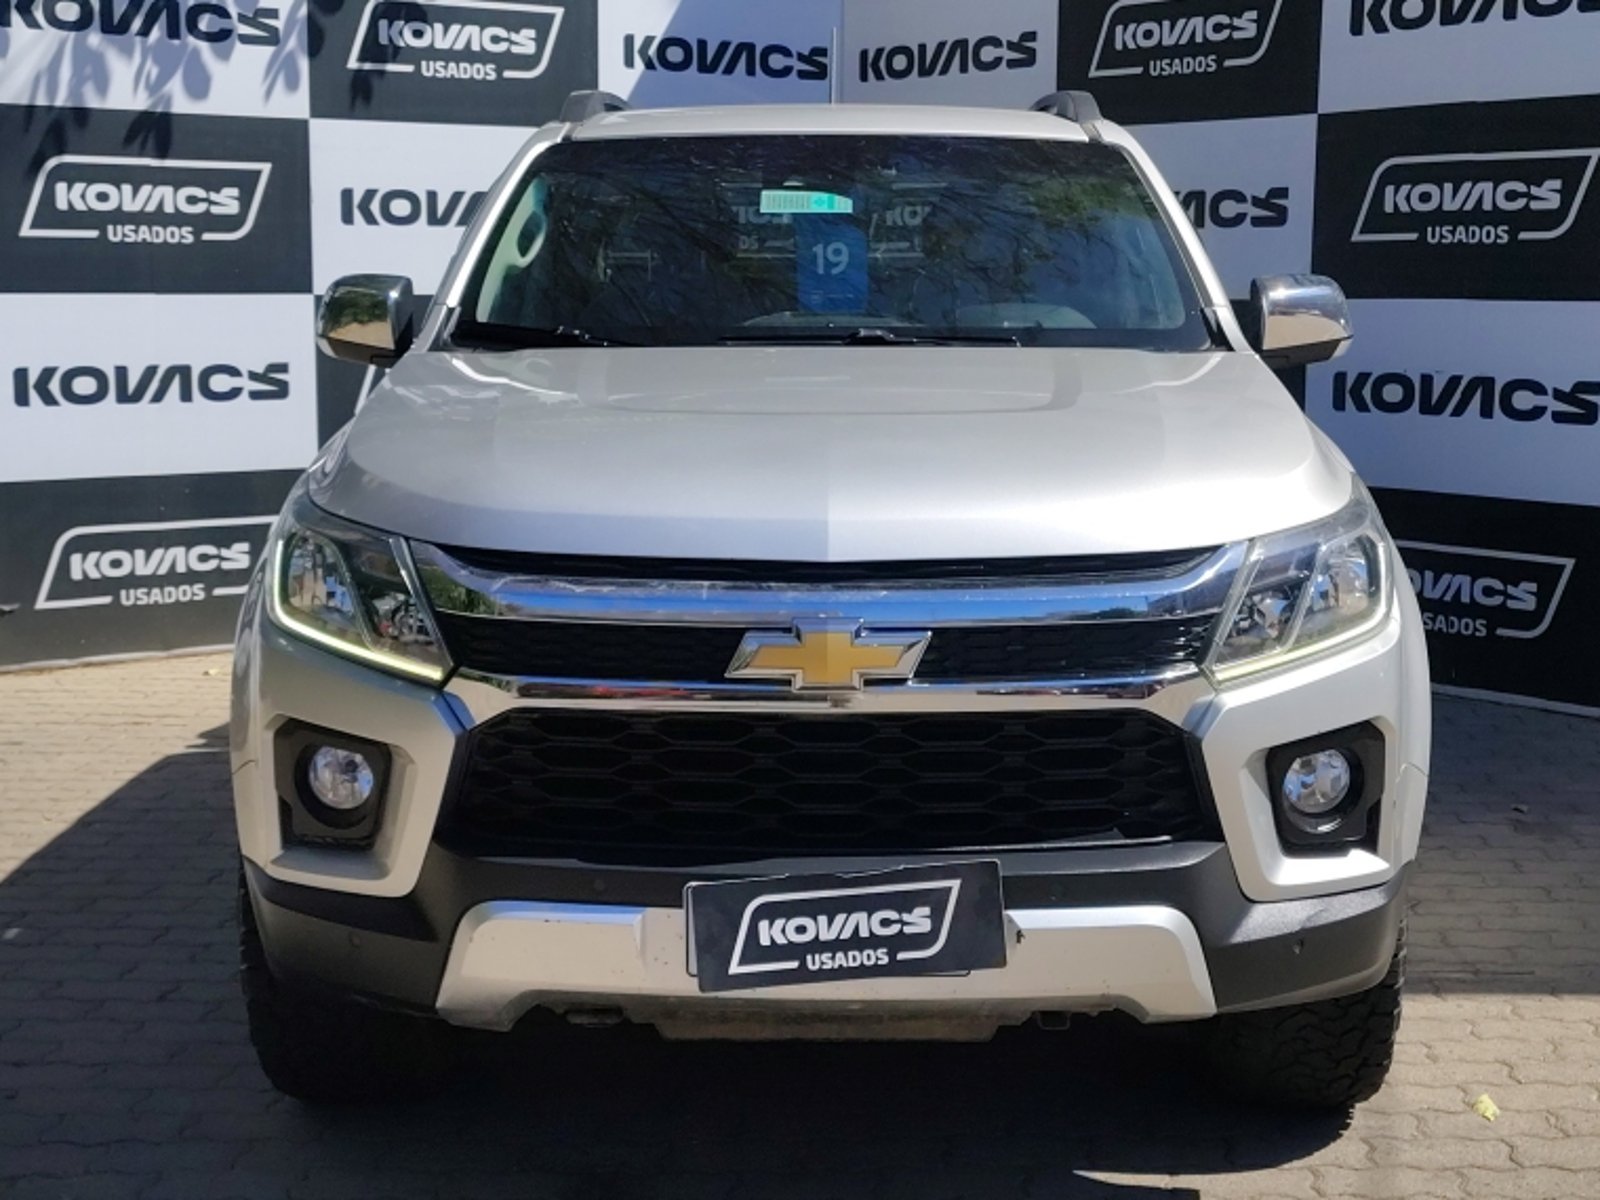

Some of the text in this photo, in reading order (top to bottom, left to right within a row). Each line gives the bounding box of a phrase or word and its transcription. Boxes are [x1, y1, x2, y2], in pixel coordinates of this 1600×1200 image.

[377, 19, 537, 55] KOVACS
[1115, 11, 1258, 50] KOVACS
[420, 60, 497, 80] USADOS
[623, 33, 828, 80] KOVACS
[859, 31, 1037, 82] KOVACS
[1149, 54, 1217, 77] USADOS
[55, 182, 240, 216] KOVACS
[340, 187, 488, 228] KOV
[1174, 187, 1289, 228] ACS
[1384, 179, 1562, 213] KOVACS
[107, 224, 194, 244] USADOS
[1426, 225, 1509, 244] USADOS
[812, 241, 849, 275] 19
[13, 362, 289, 406] KOVACS
[1332, 371, 1600, 425] KOVACS
[69, 543, 250, 581] KOVACS
[120, 583, 205, 606] USADOS
[1422, 612, 1487, 637] SADOS
[757, 906, 932, 946] KOVACS
[806, 948, 889, 971] USADOS
